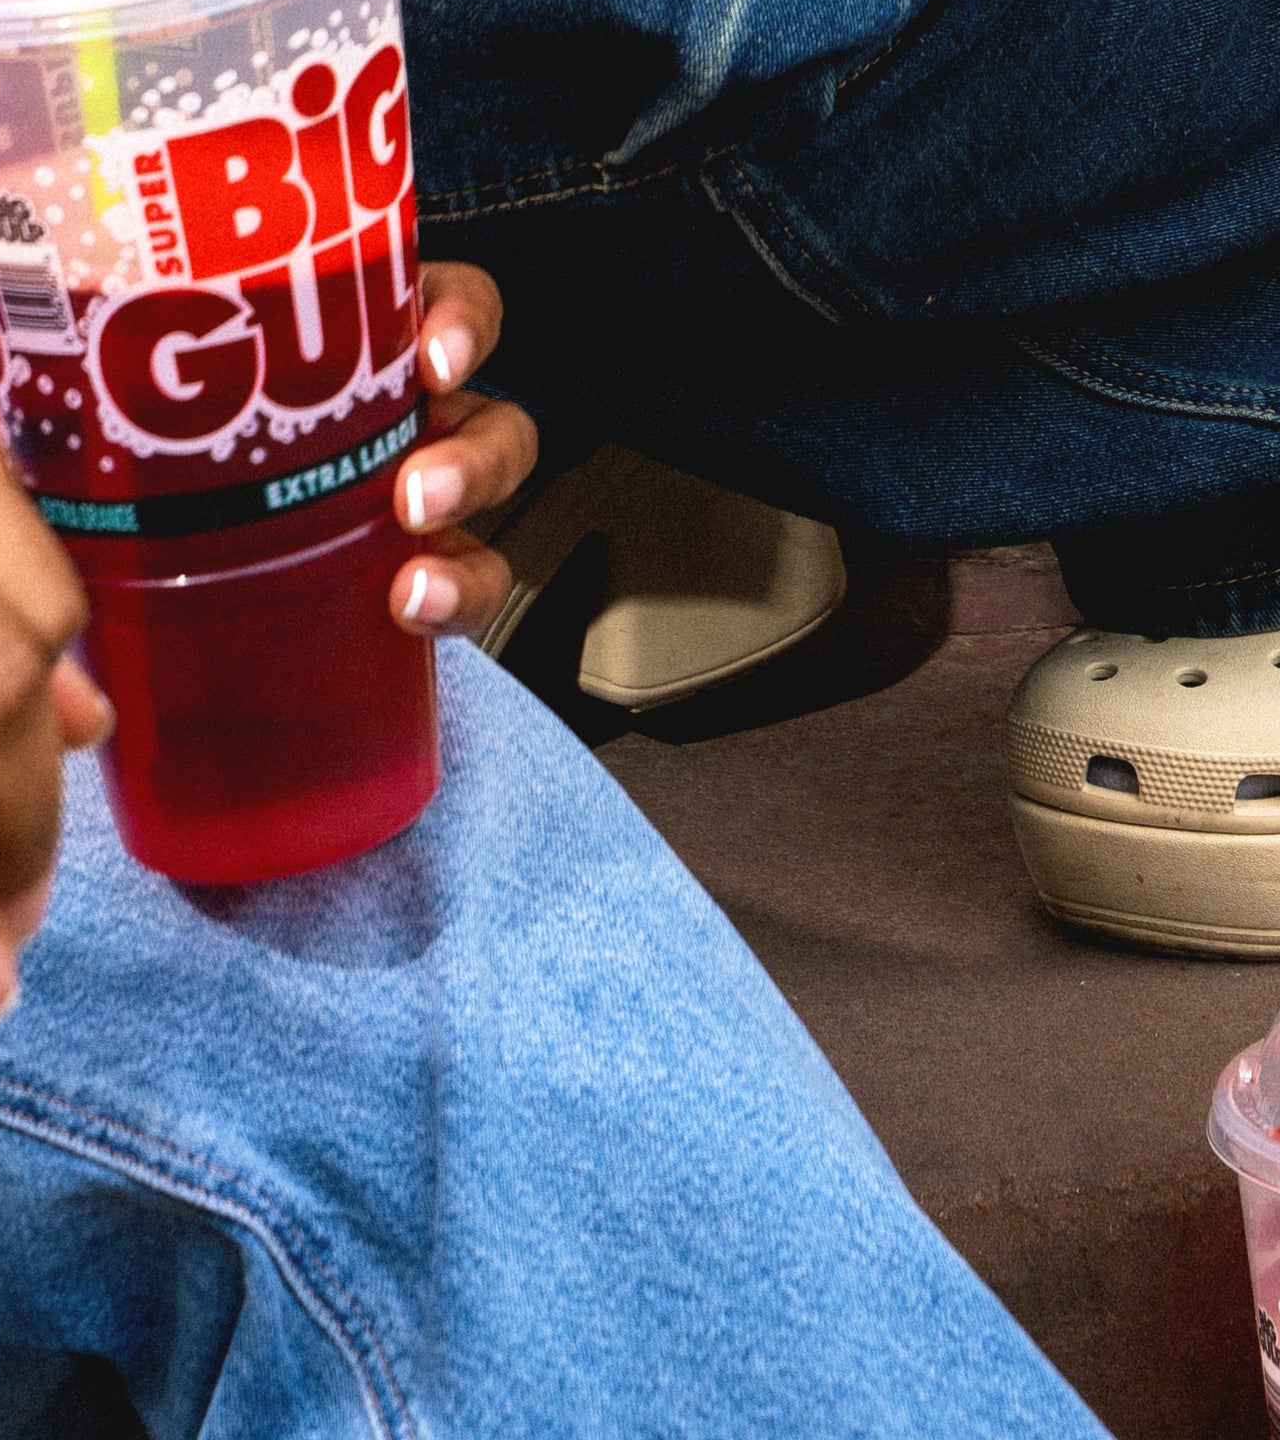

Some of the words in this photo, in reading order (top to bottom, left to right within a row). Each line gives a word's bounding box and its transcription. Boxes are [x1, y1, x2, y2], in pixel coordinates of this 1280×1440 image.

[134, 150, 184, 276] SUPER
[100, 208, 418, 438] GUL
[265, 453, 357, 511] EXTRA
